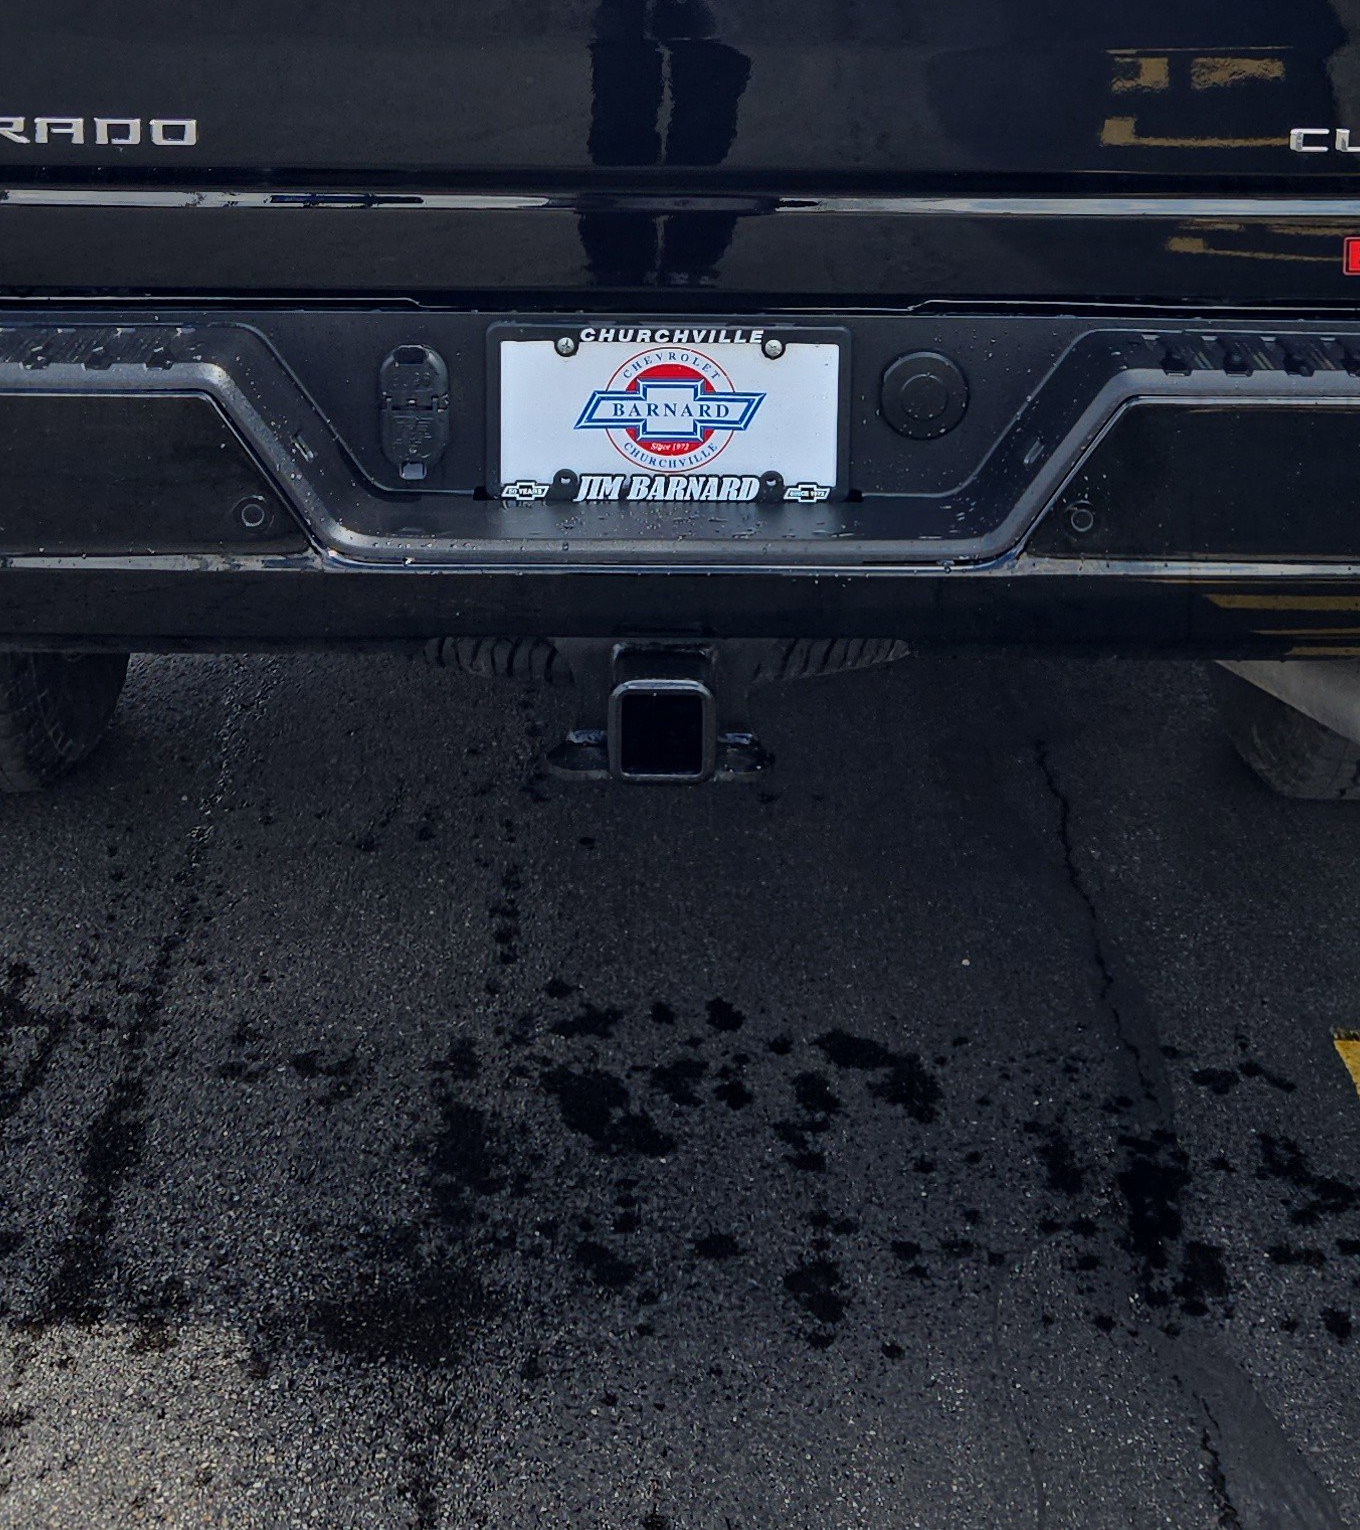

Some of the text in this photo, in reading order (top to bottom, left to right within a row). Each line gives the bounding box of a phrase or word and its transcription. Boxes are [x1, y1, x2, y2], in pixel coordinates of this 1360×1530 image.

[580, 328, 765, 344] CHURCHVILLE
[623, 351, 721, 379] CHEVROLET
[612, 402, 730, 418] BARNARD
[623, 442, 718, 469] CHURCHVILLE
[574, 474, 761, 502] JIM BARNARD
